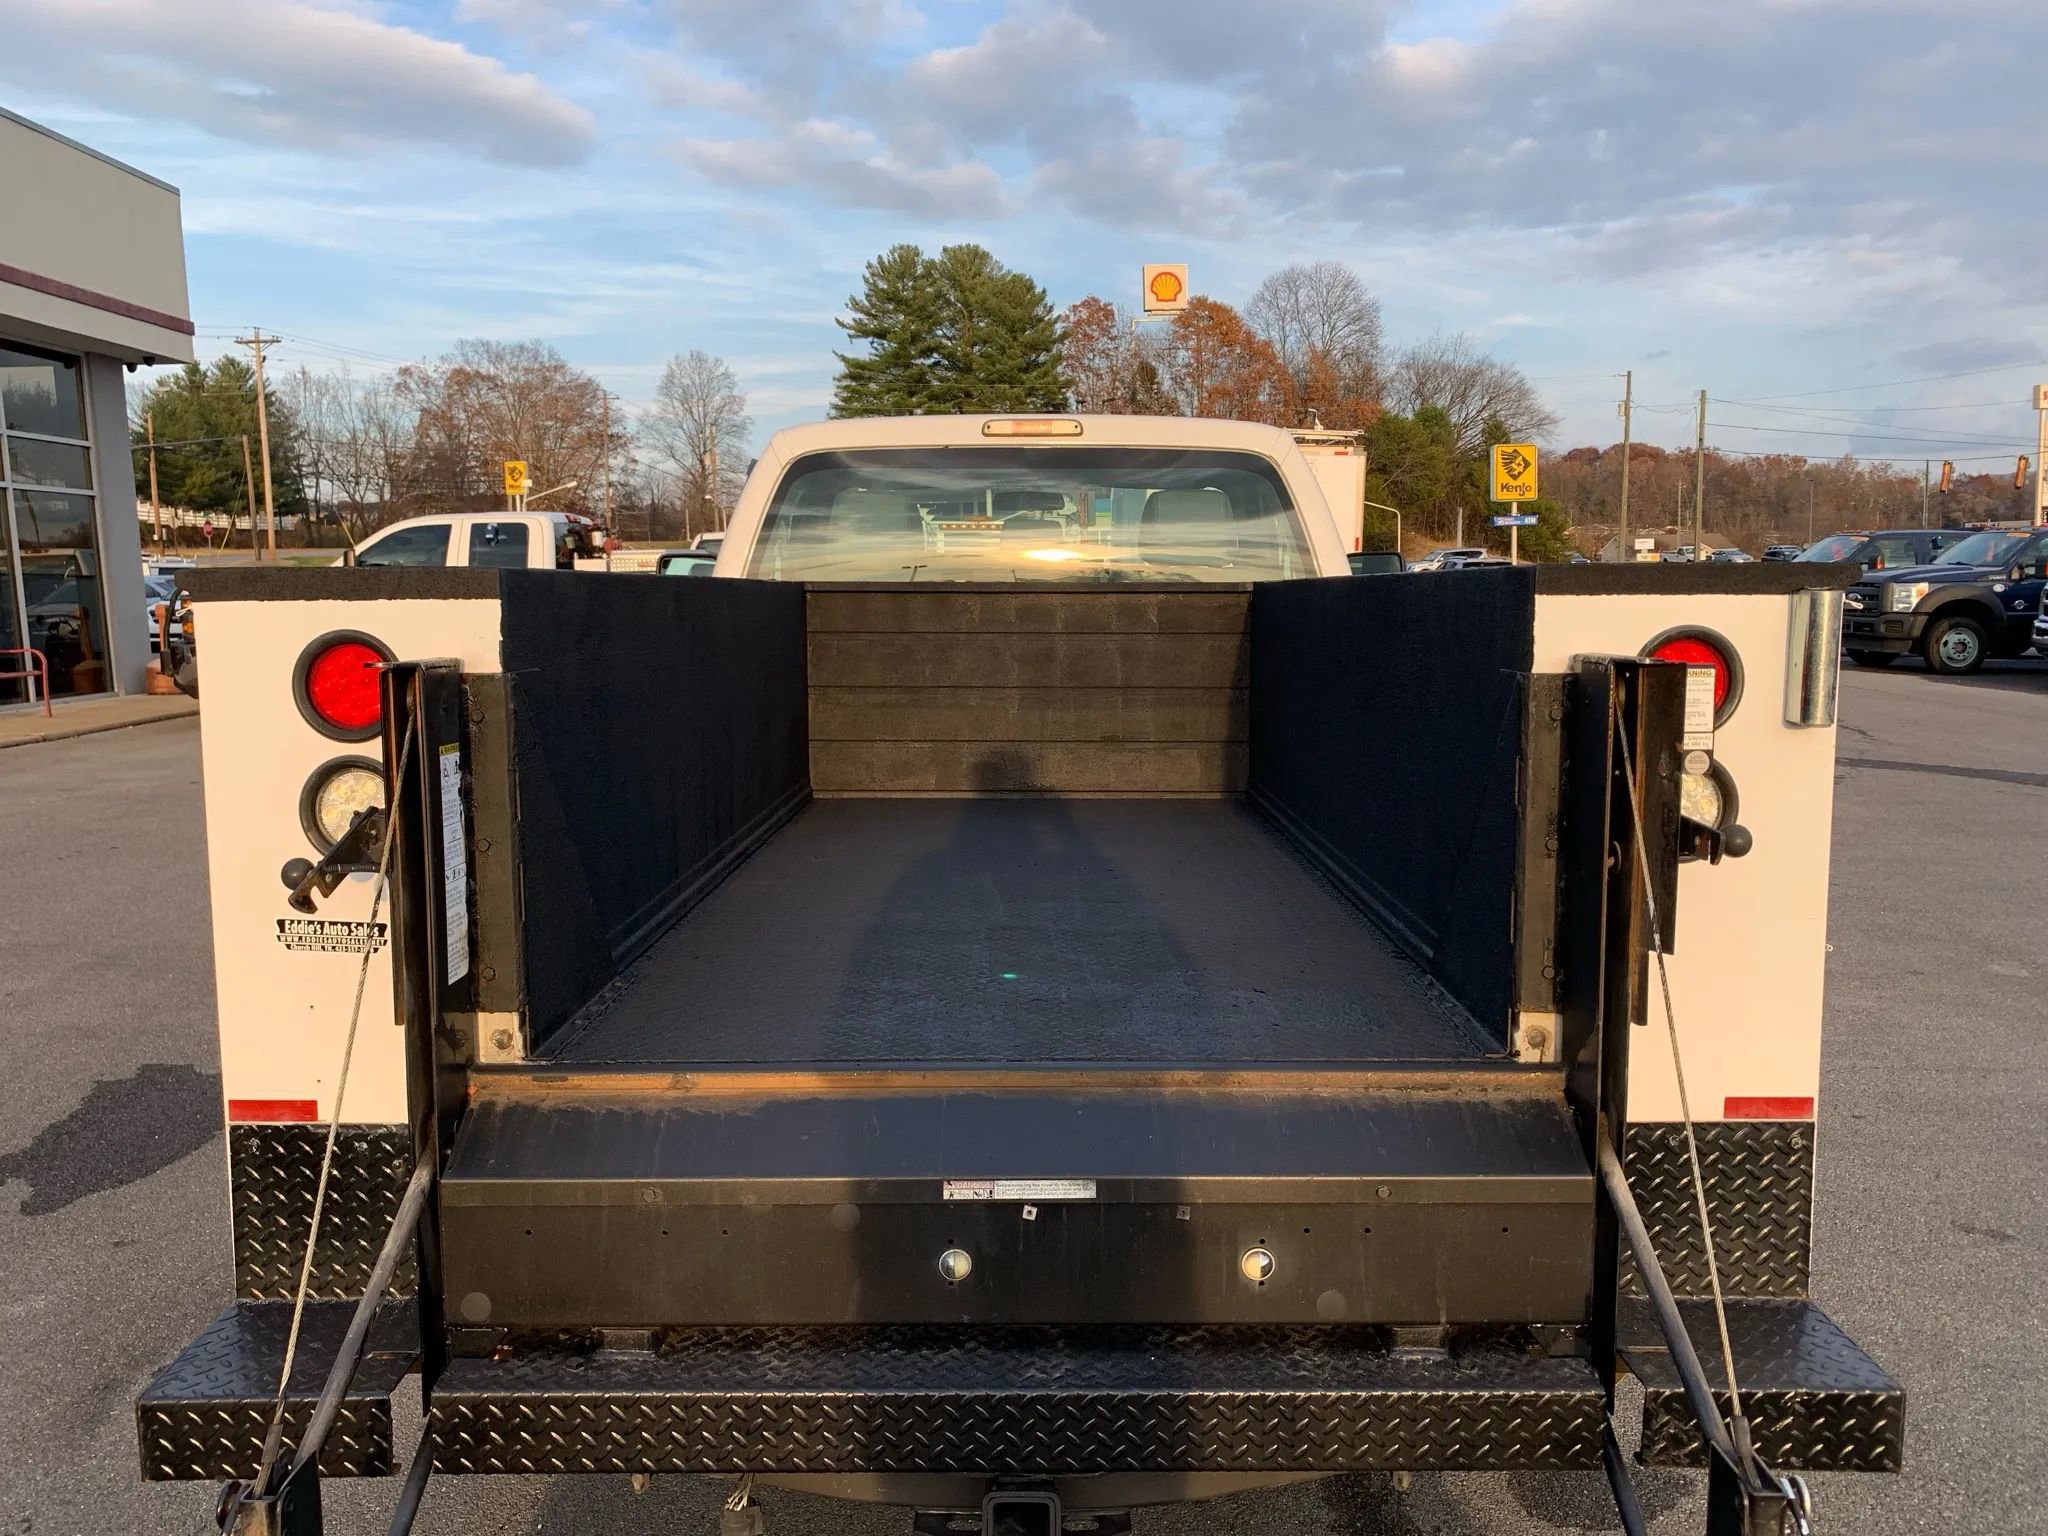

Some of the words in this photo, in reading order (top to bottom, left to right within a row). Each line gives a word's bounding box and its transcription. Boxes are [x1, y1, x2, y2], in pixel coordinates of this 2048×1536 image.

[284, 919, 322, 935] Eddie's
[322, 921, 349, 936] Auto
[279, 935, 385, 946] WWW.EDDIESAUTOSALESNET
